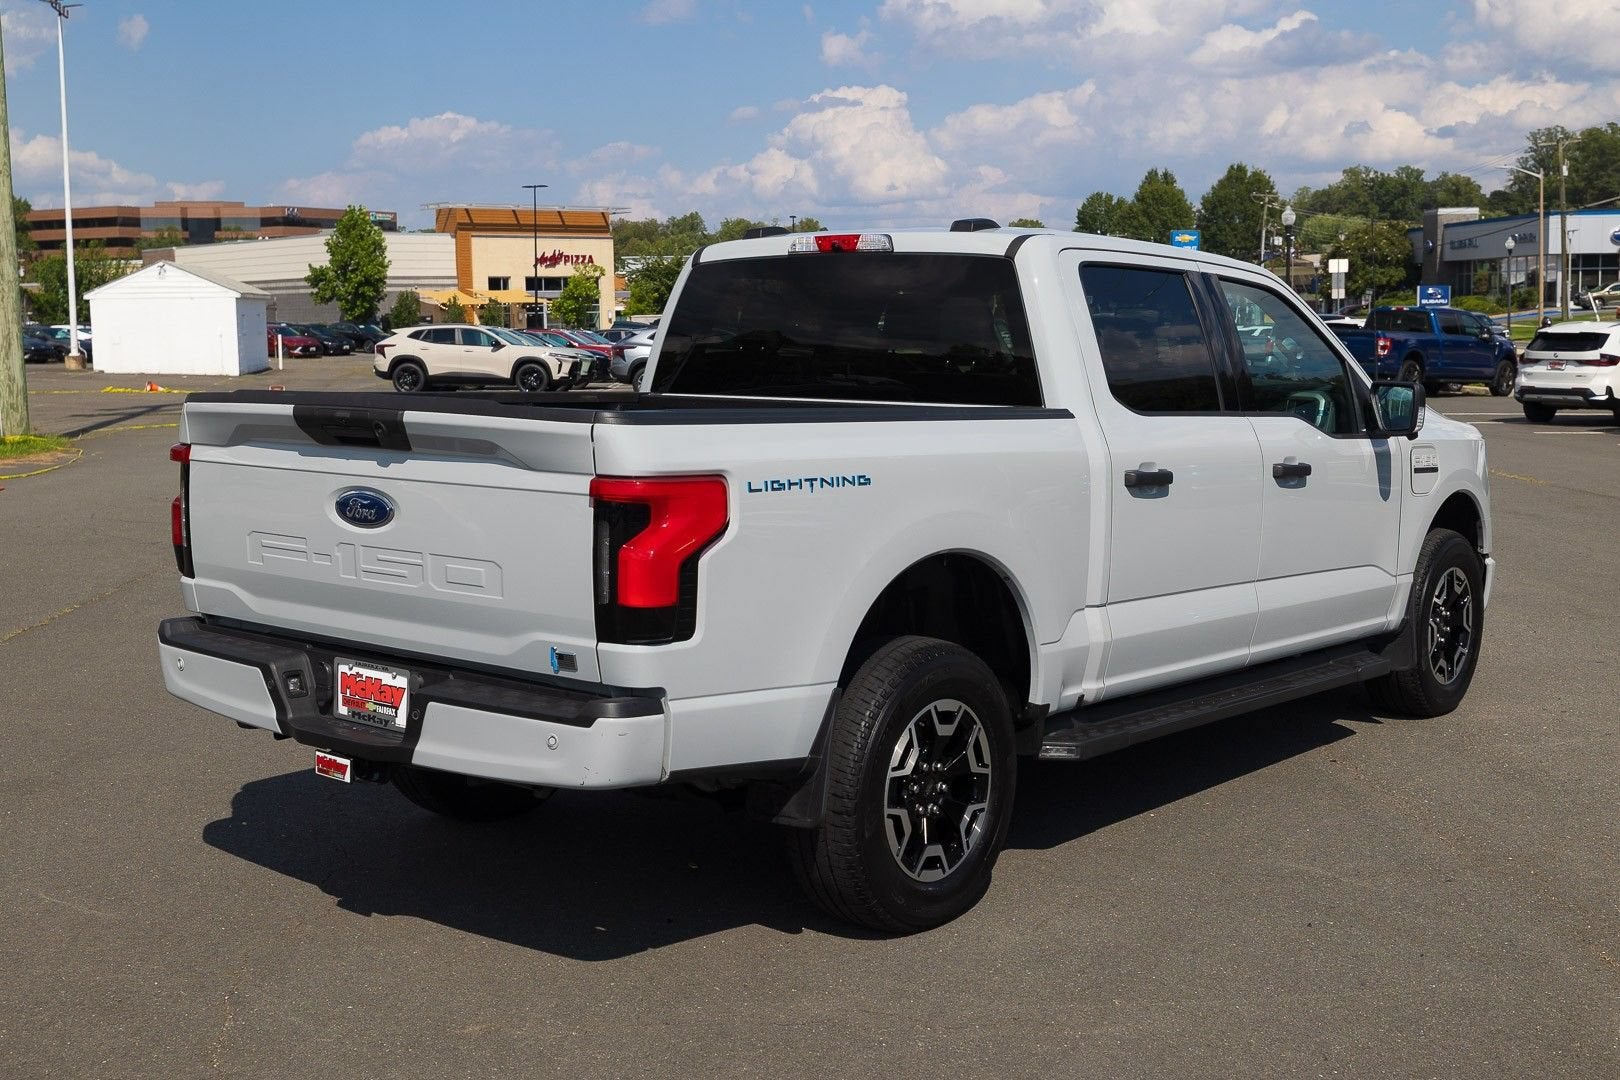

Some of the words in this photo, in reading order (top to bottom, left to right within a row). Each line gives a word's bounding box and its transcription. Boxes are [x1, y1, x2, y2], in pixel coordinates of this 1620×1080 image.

[563, 254, 594, 265] PIZZA
[747, 474, 872, 494] LIGHTNING
[346, 497, 378, 520] Ford
[247, 530, 504, 600] F-150
[340, 672, 406, 709] McKay
[351, 710, 391, 727] McKay
[376, 705, 396, 716] FAIRFAX
